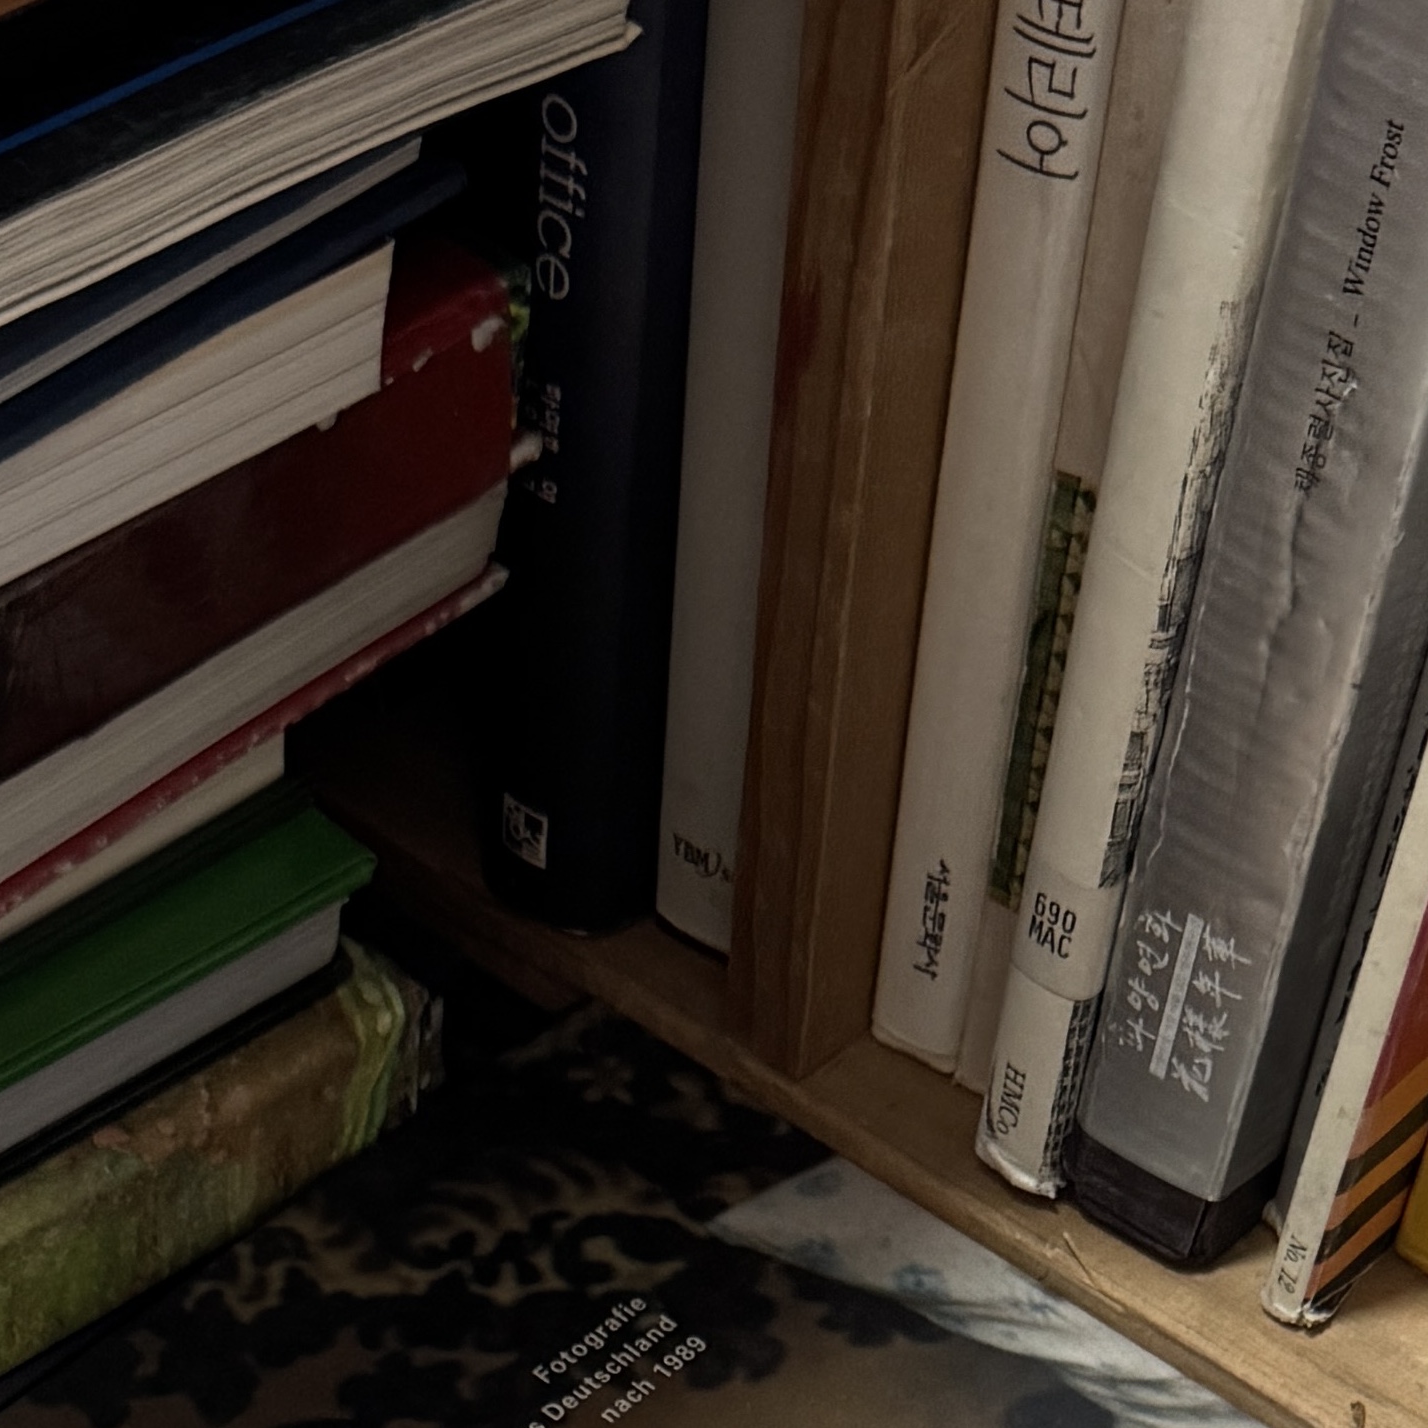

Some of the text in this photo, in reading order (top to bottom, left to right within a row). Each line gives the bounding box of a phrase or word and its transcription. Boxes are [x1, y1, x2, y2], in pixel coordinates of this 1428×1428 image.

[1343, 119, 1405, 298] Window Frost
[1029, 920, 1072, 960] MAC
[1035, 892, 1076, 935] 690
[995, 1062, 1027, 1136] HMCo
[1283, 1235, 1307, 1264] No.
[532, 1297, 647, 1384] Fotografie
[541, 1314, 677, 1421] Deutschland
[600, 1335, 707, 1423] nach 1989
